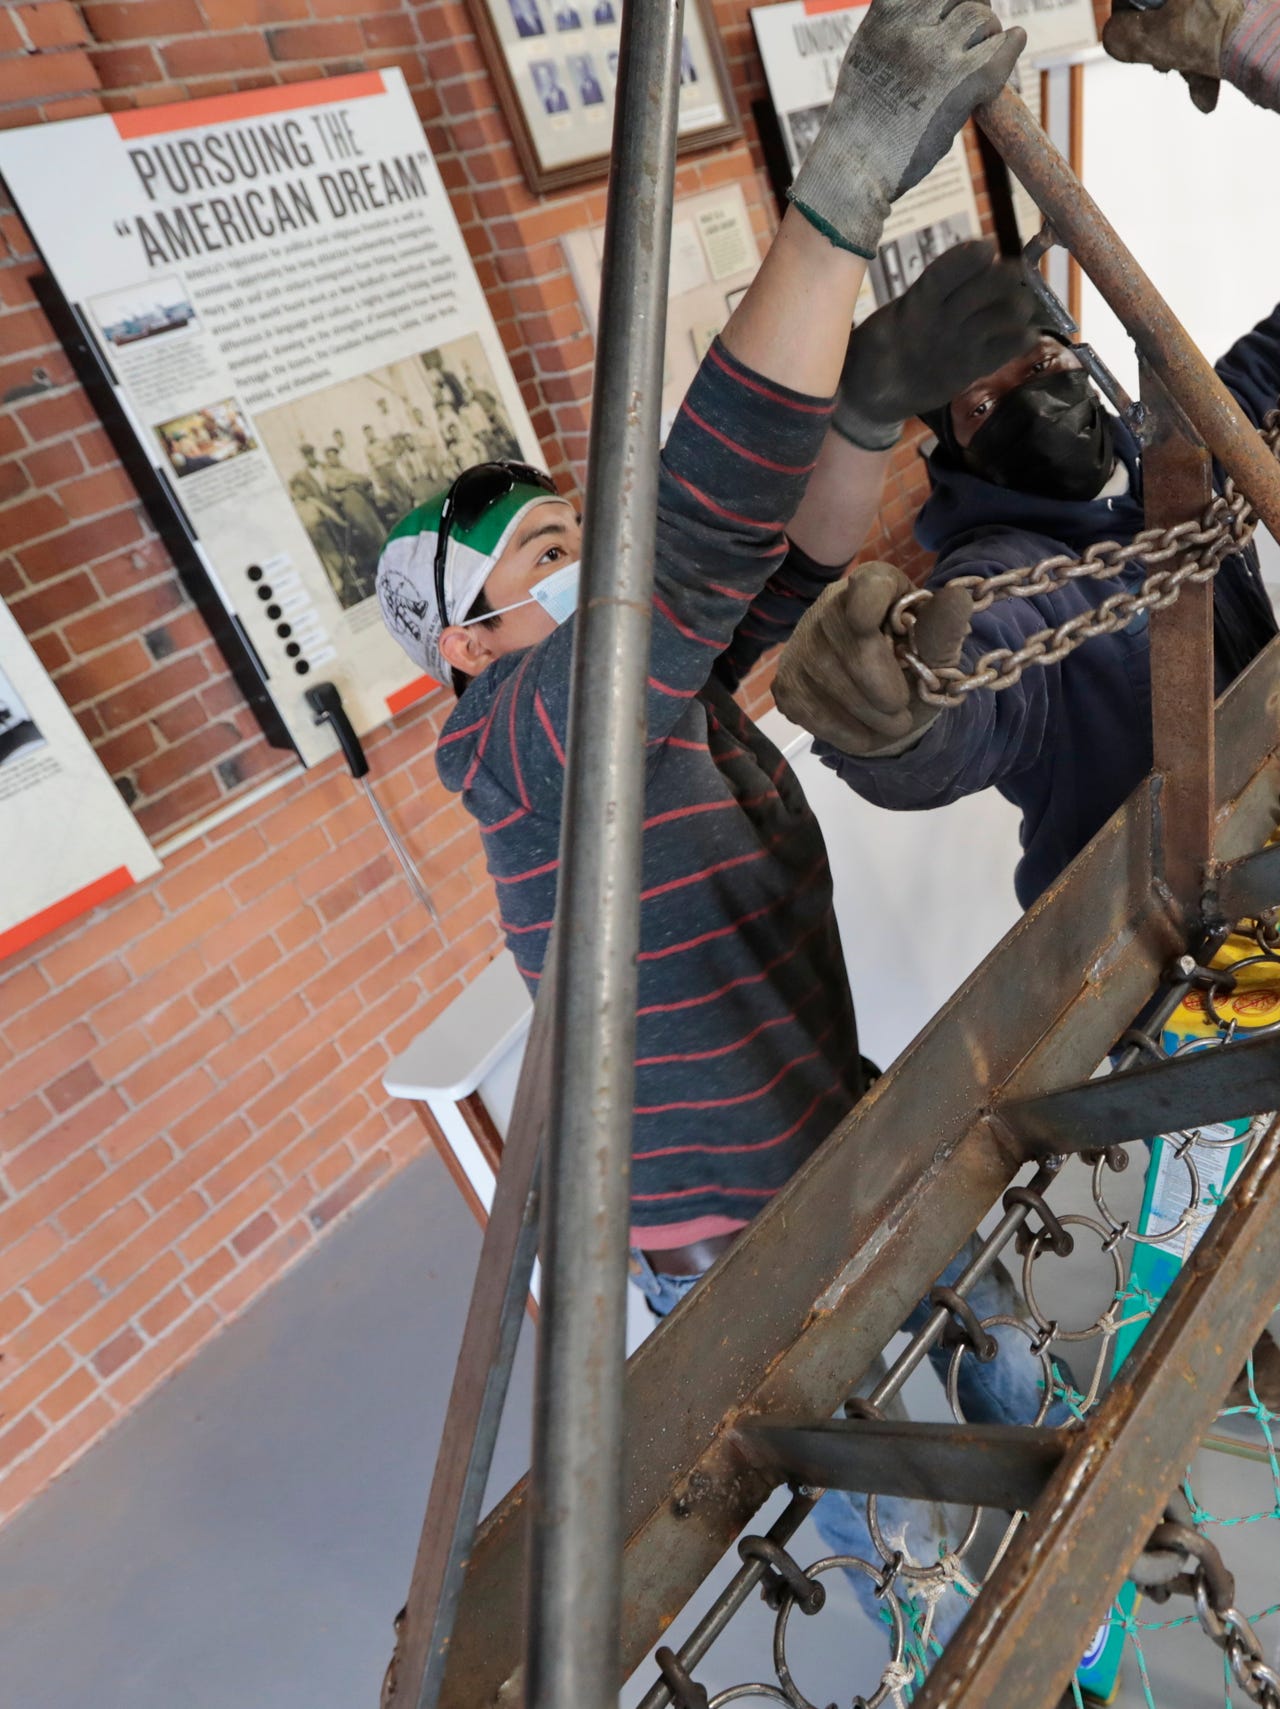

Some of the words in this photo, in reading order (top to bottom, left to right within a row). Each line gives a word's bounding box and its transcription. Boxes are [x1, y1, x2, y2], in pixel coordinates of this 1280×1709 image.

[127, 118, 315, 201] PURSUING
[310, 110, 363, 162] THE
[114, 178, 319, 267] “AMERICAN
[317, 151, 430, 219] DREAM”
